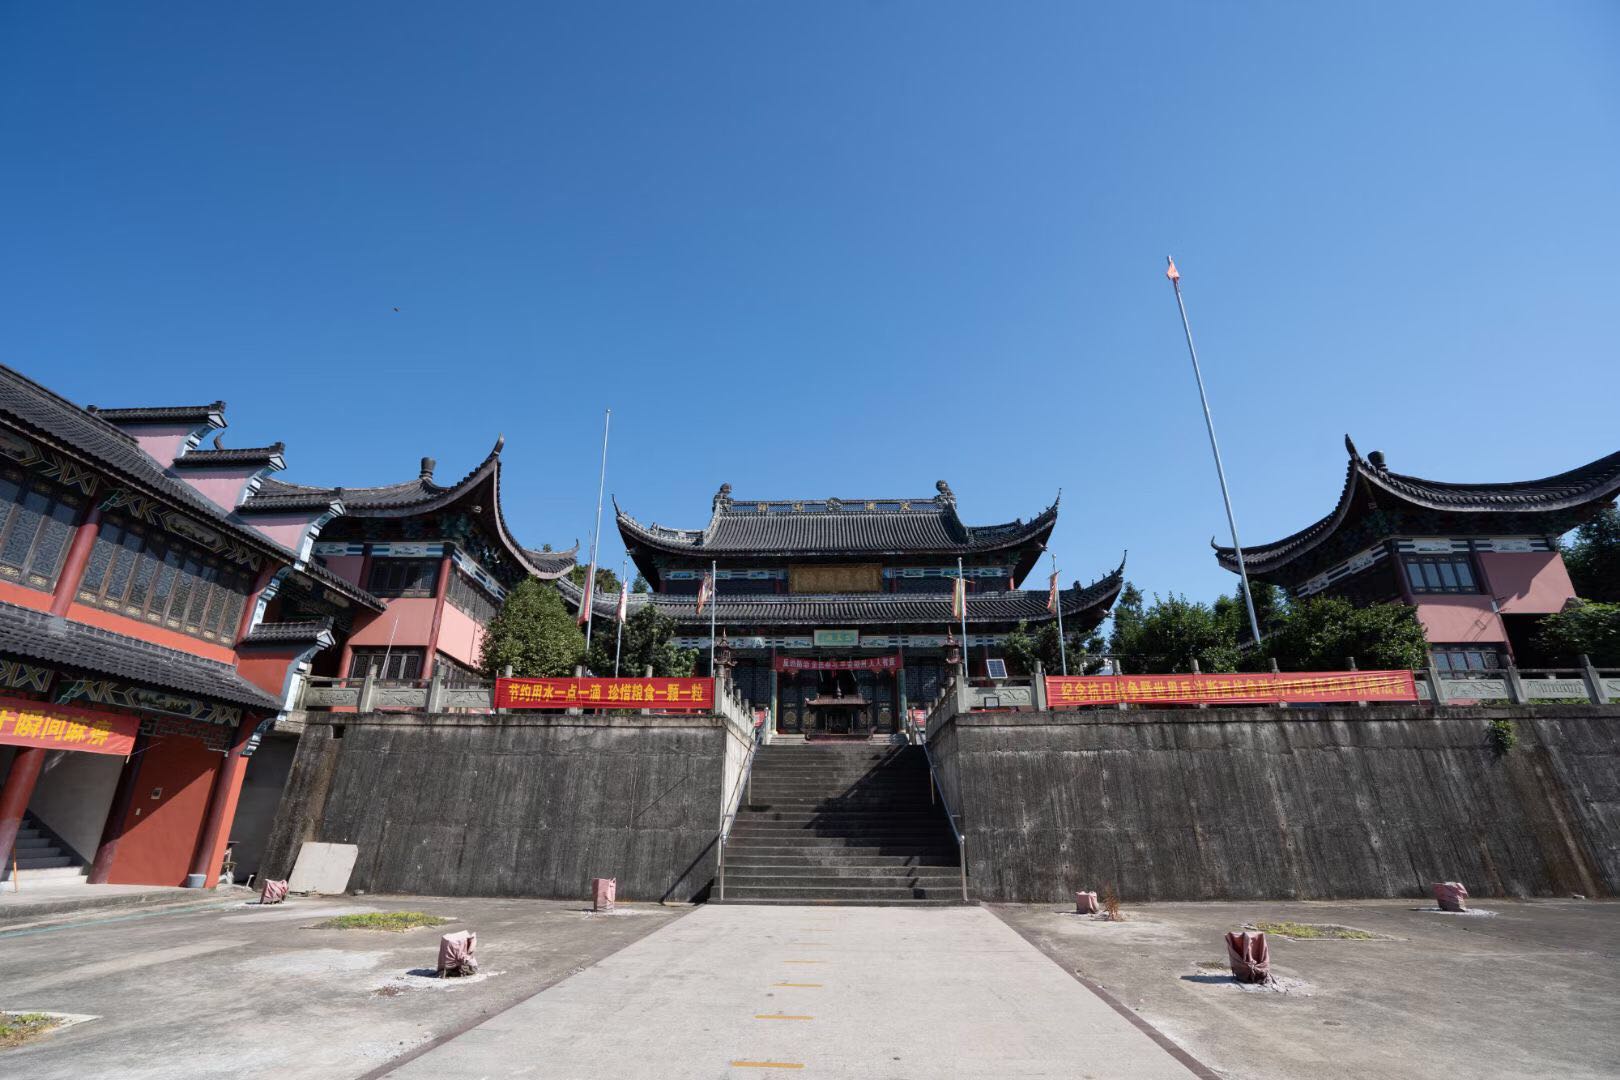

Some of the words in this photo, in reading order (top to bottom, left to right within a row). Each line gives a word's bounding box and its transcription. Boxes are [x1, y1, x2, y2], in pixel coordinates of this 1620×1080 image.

[508, 684, 602, 702] 节约用水一点一滴
[608, 684, 703, 702] 珍惜粮食一颗一粒
